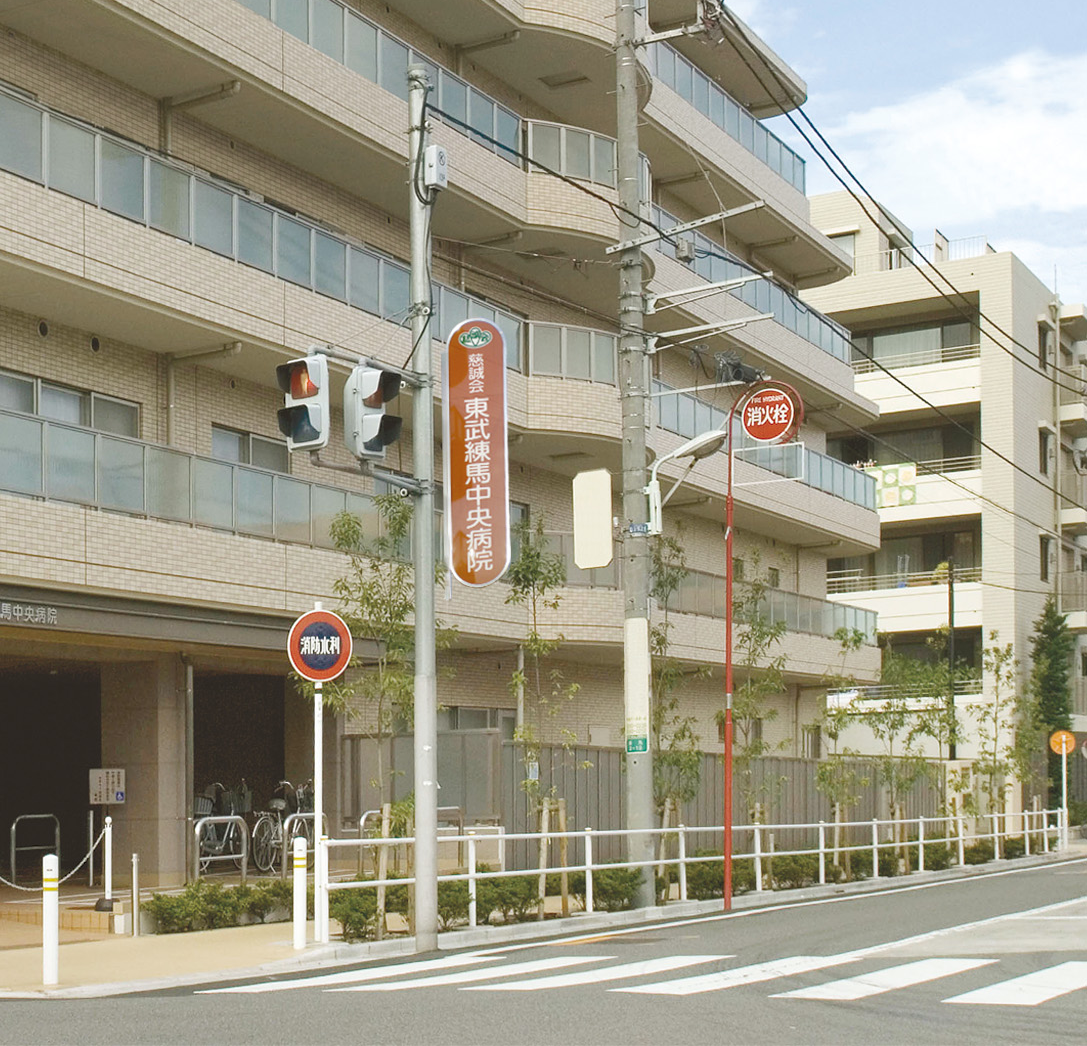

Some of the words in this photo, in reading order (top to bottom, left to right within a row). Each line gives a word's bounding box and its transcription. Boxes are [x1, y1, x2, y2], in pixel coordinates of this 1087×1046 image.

[468, 353, 484, 393] 慈誠会
[747, 403, 789, 427] 消火栓
[464, 397, 493, 573] 東武練馬中央病院
[300, 636, 340, 655] 消防水利
